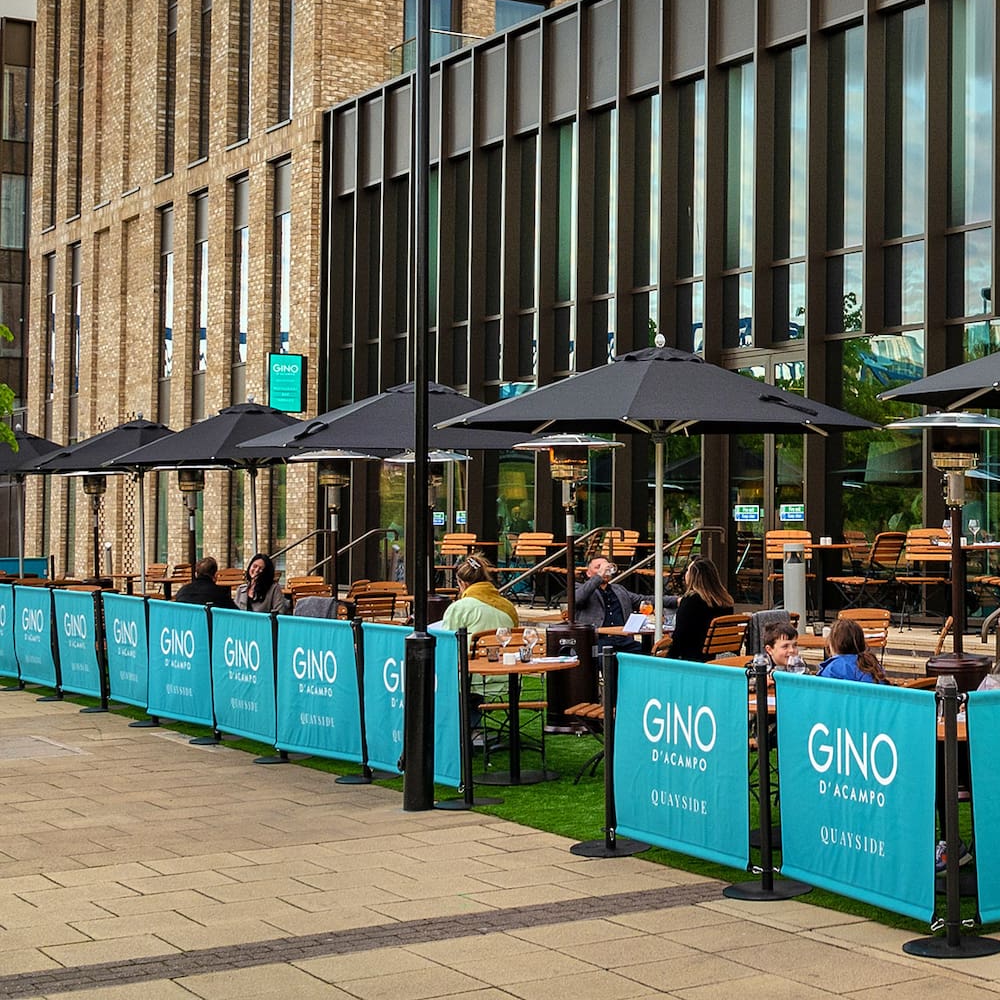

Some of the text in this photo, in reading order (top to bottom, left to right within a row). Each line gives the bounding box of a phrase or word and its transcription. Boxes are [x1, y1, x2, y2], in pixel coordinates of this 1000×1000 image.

[272, 363, 299, 374] GINO
[22, 607, 44, 633] GINO
[64, 612, 87, 640] GINO
[113, 618, 138, 648] GINO
[160, 626, 195, 659] GINO
[223, 636, 260, 672] GINO
[292, 646, 337, 684] GINO
[299, 683, 333, 698] D'ACAMPO
[642, 698, 717, 752] GINO
[651, 749, 707, 772] D'ACAMPO
[808, 722, 898, 786] GINO
[651, 788, 708, 815] QUAYSIDE
[819, 779, 886, 808] D'ACAMPO
[820, 825, 886, 857] QUAYSIDE
